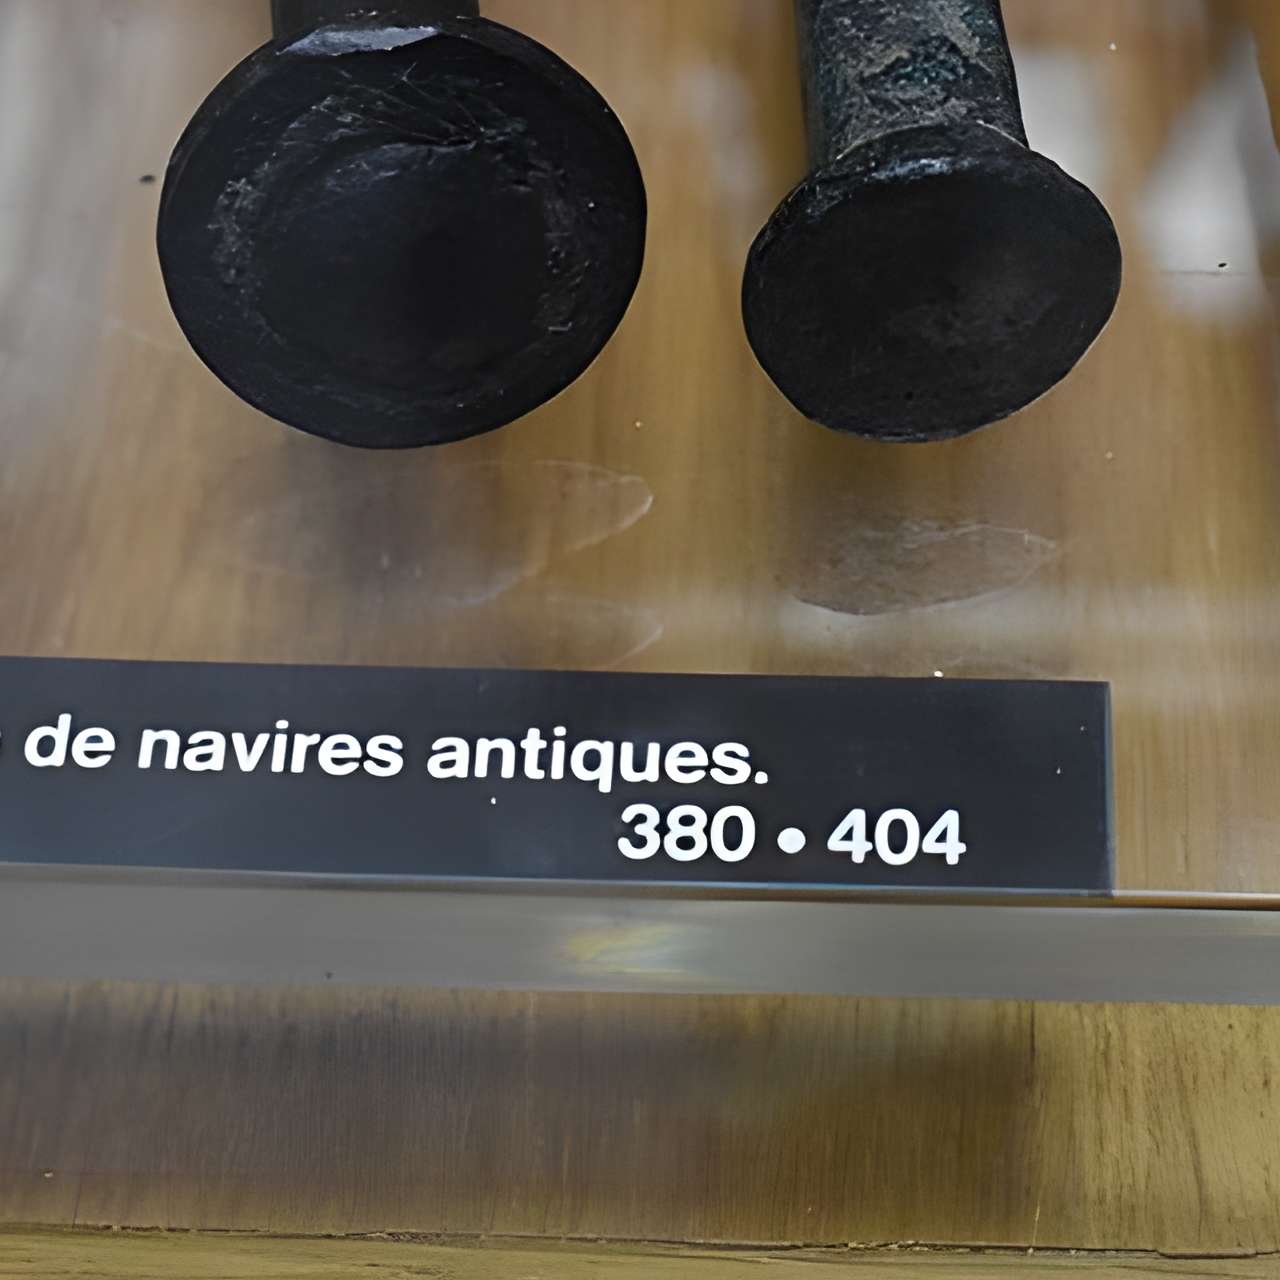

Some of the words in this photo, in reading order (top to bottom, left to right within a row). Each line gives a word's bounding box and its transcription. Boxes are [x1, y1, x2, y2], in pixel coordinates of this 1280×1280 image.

[23, 713, 117, 770] de
[136, 718, 405, 778] navires
[425, 724, 770, 795] antiques.
[616, 802, 757, 863] 380
[825, 807, 968, 867] 404
